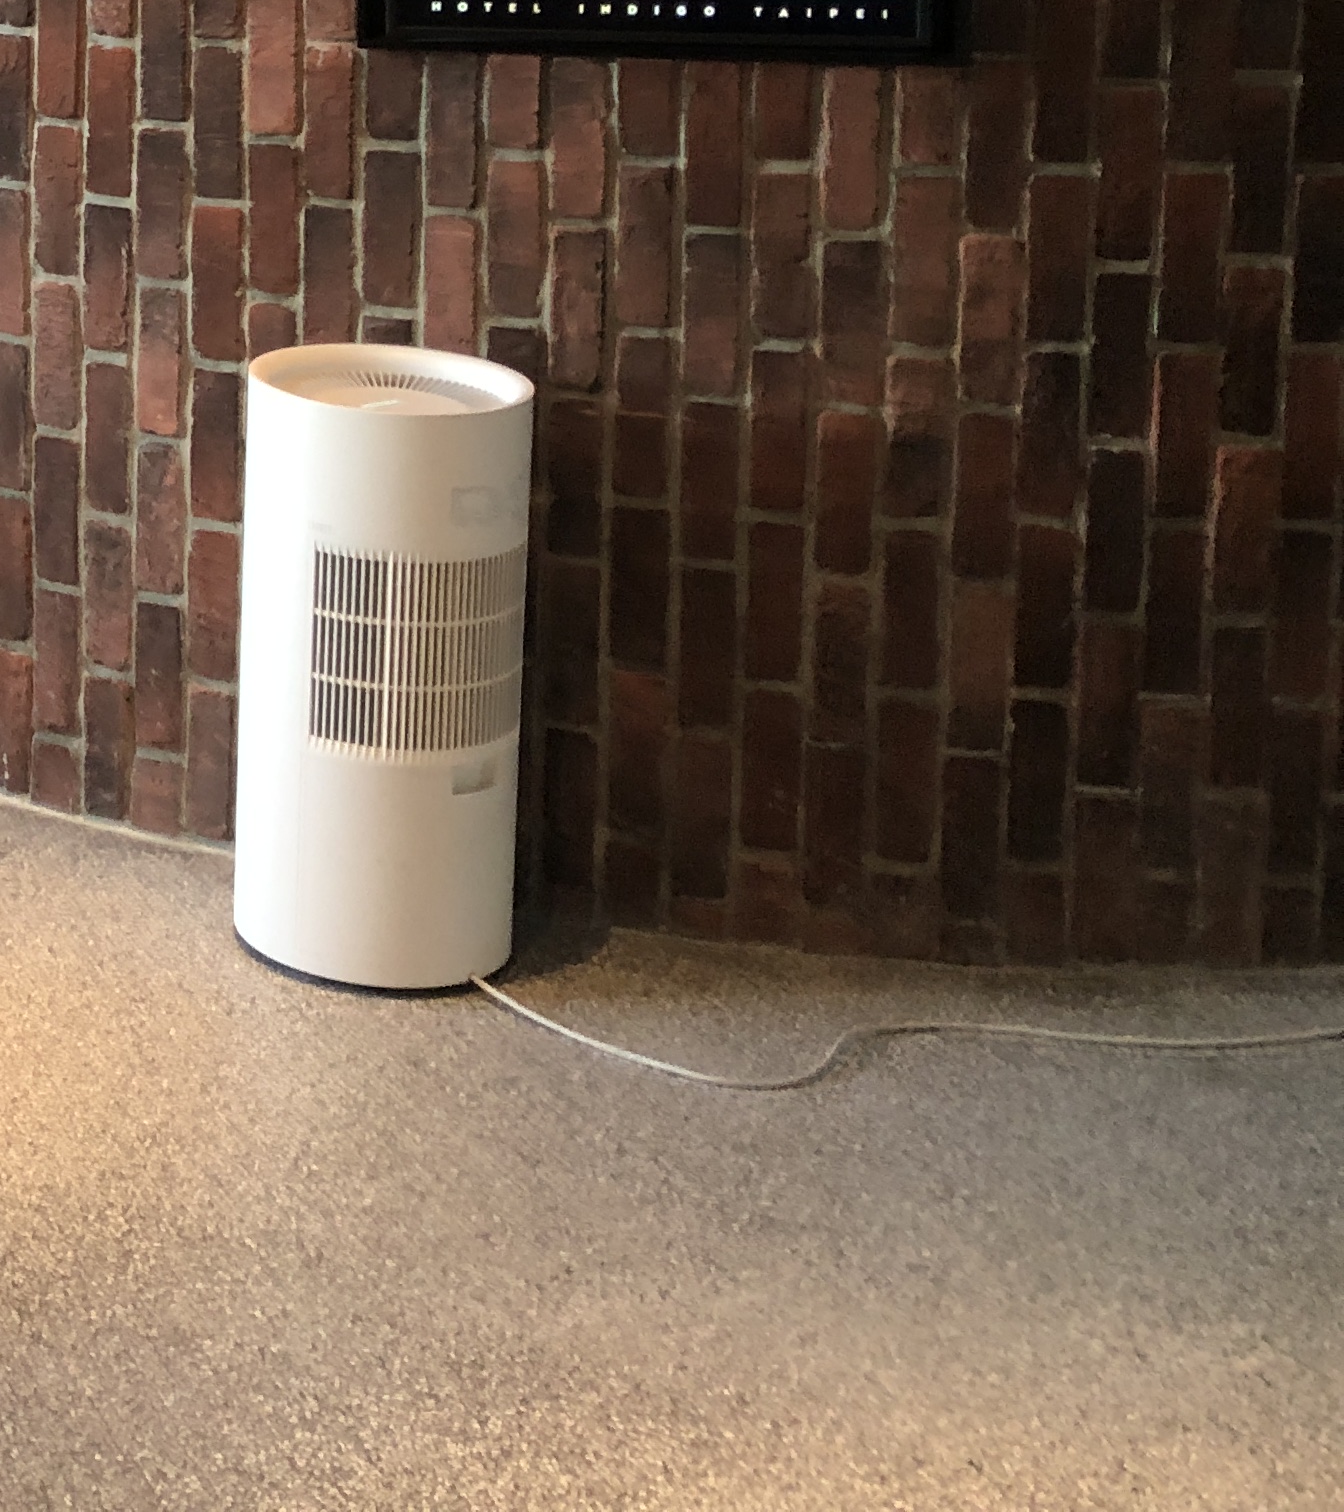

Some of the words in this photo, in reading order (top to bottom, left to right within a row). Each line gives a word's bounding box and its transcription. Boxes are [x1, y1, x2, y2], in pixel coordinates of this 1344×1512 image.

[431, 1, 542, 14] HOTEL
[578, 3, 716, 17] INDIGO
[753, 6, 888, 20] TAIPEI
